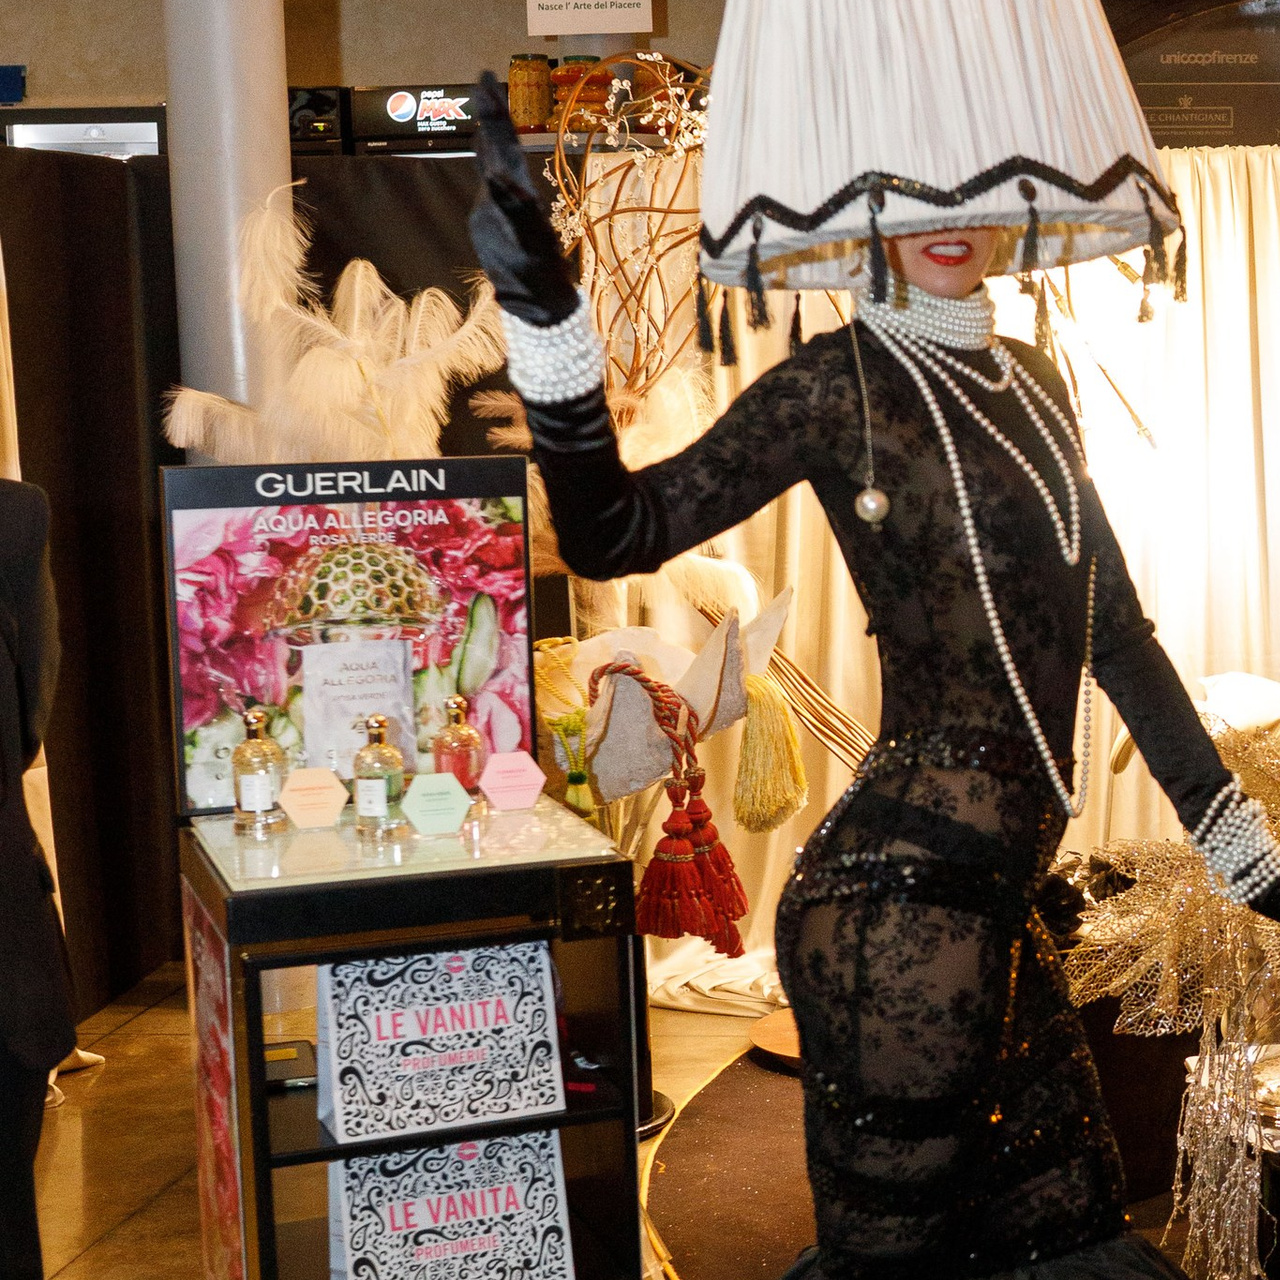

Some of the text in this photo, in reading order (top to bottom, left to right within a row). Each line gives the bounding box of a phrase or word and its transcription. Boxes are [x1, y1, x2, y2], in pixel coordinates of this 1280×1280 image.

[538, 2, 563, 11] Nasce
[573, 2, 592, 10] Arte
[594, 1, 608, 9] del
[610, 0, 642, 10] Piacere
[1159, 51, 1259, 66] unicoopfirenze
[421, 89, 444, 100] pepsi
[417, 97, 470, 121] MAX
[1158, 113, 1228, 123] CHIANTIGIANE
[254, 468, 446, 498] GUERLAIN
[252, 508, 450, 533] AQUA ALLEGORIA
[309, 531, 396, 546] ROSA VERDE
[341, 661, 379, 671] AQUA
[375, 1011, 406, 1041] LE
[402, 1047, 489, 1072] PROFUMERIE
[388, 1202, 418, 1232] LE
[414, 1233, 501, 1261] PROFUMERIE
